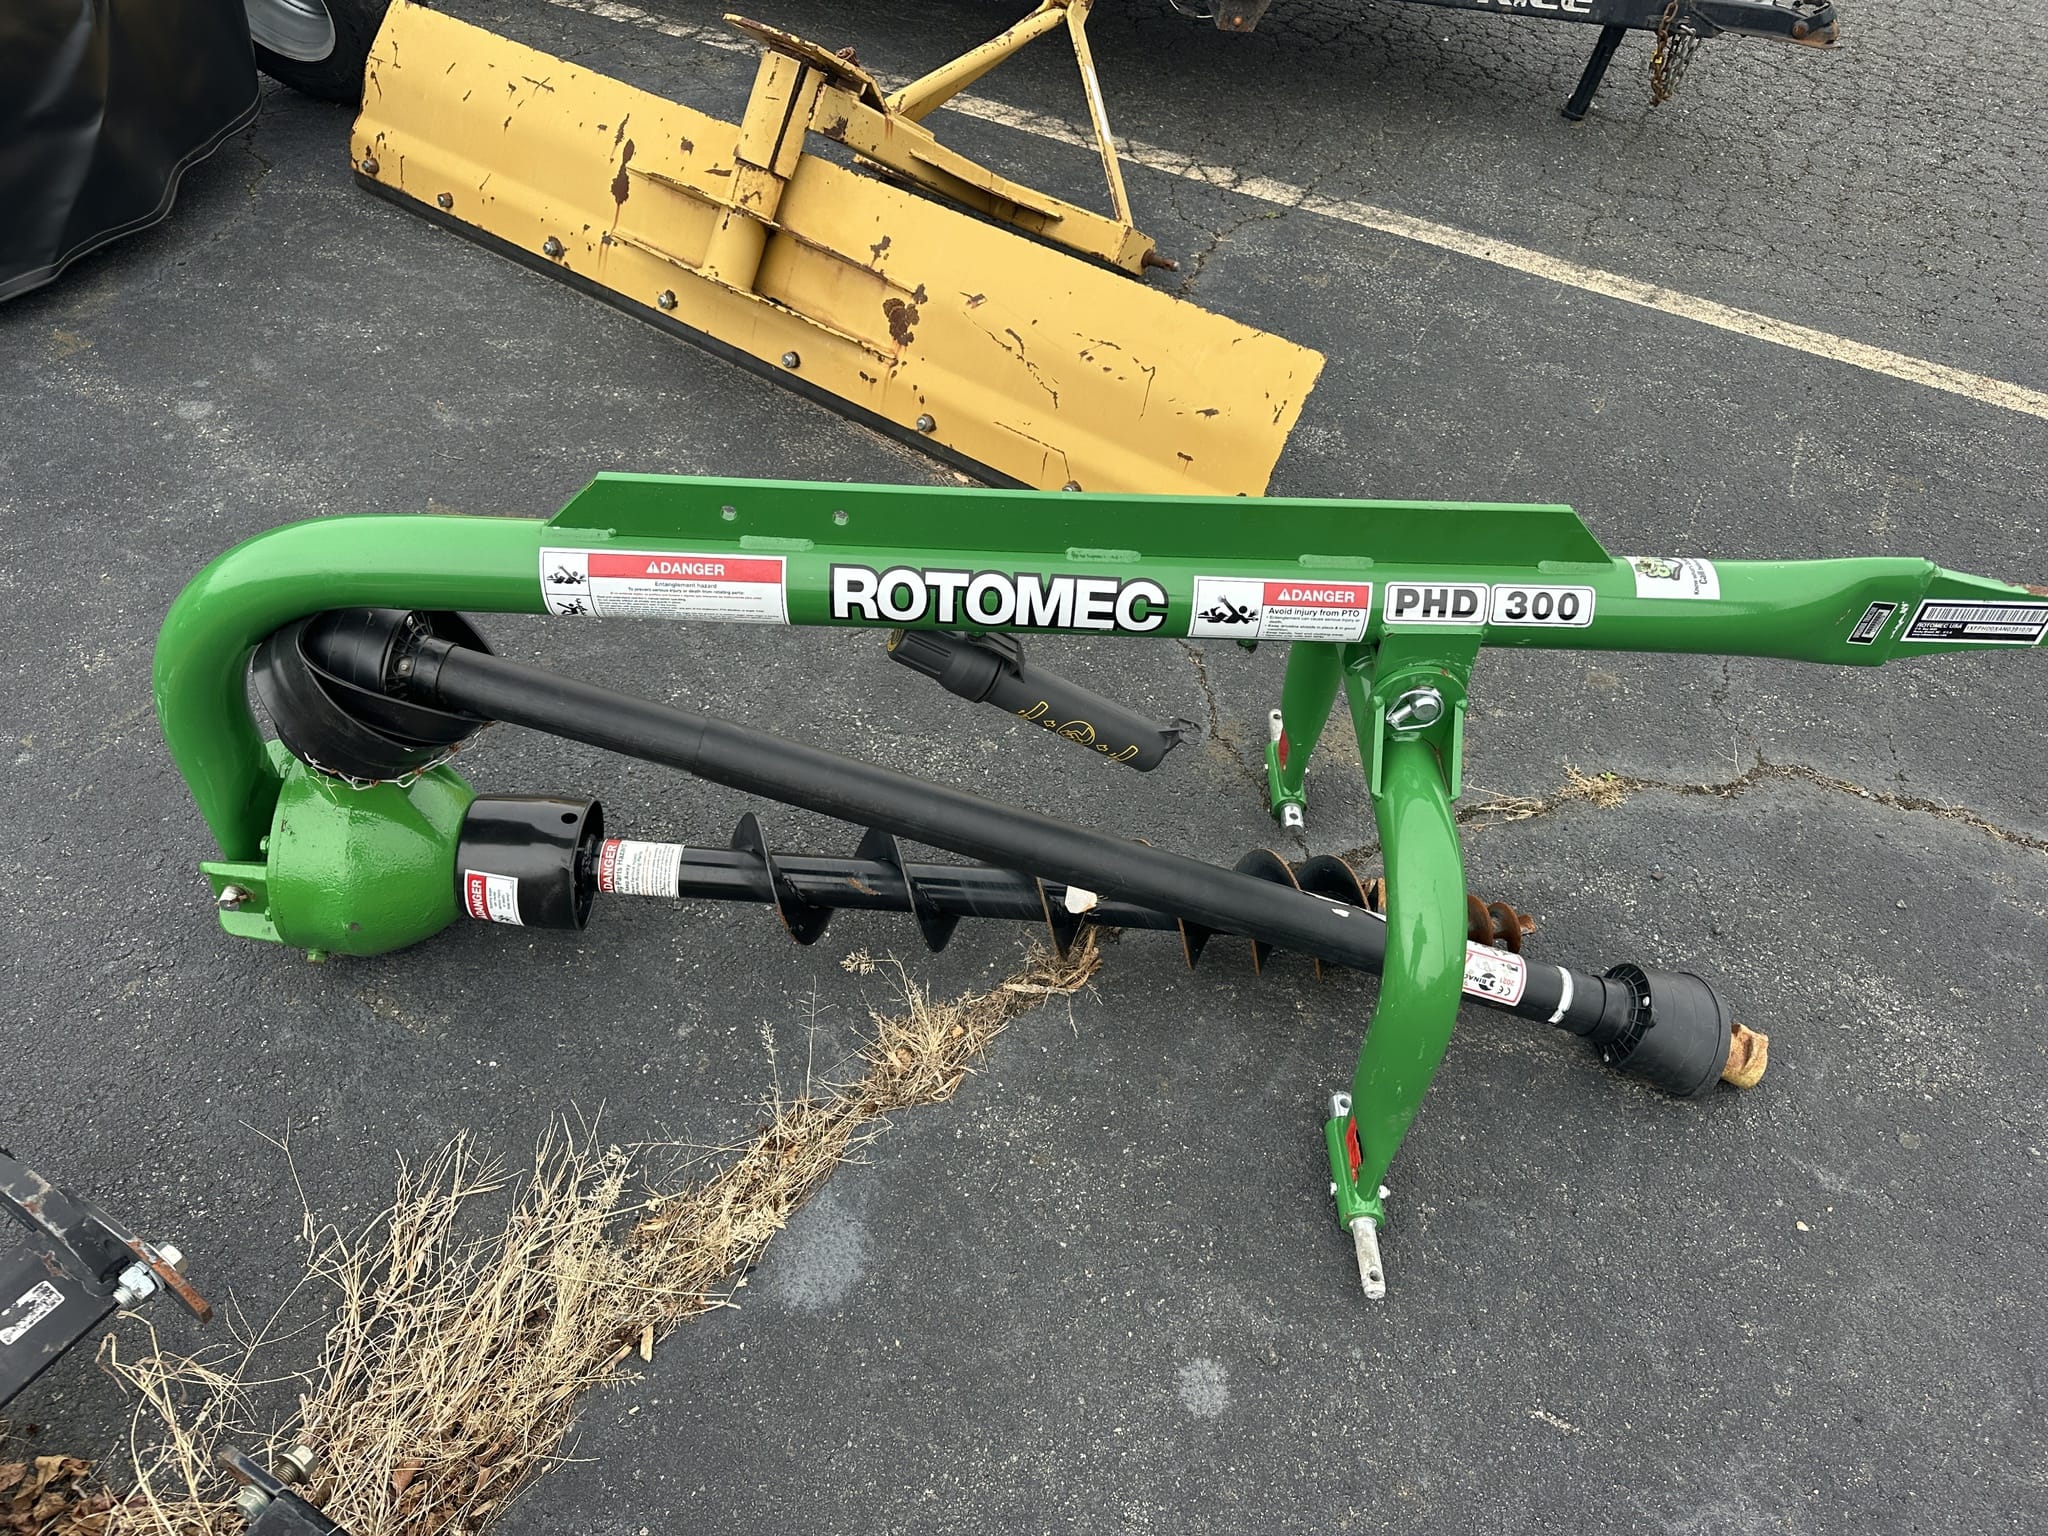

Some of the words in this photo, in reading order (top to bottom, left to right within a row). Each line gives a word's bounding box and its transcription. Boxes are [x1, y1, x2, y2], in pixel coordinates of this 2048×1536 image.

[661, 562, 724, 576] DANGER
[831, 564, 1167, 632] ROTOMEC
[1292, 589, 1355, 603] DANGER
[1395, 588, 1478, 618] PHD
[1505, 591, 1579, 621] 300
[1294, 608, 1317, 617] injury
[1342, 610, 1360, 618] PTO
[604, 844, 617, 890] DANGER
[472, 880, 486, 916] DANGER
[1497, 986, 1511, 996] CE
